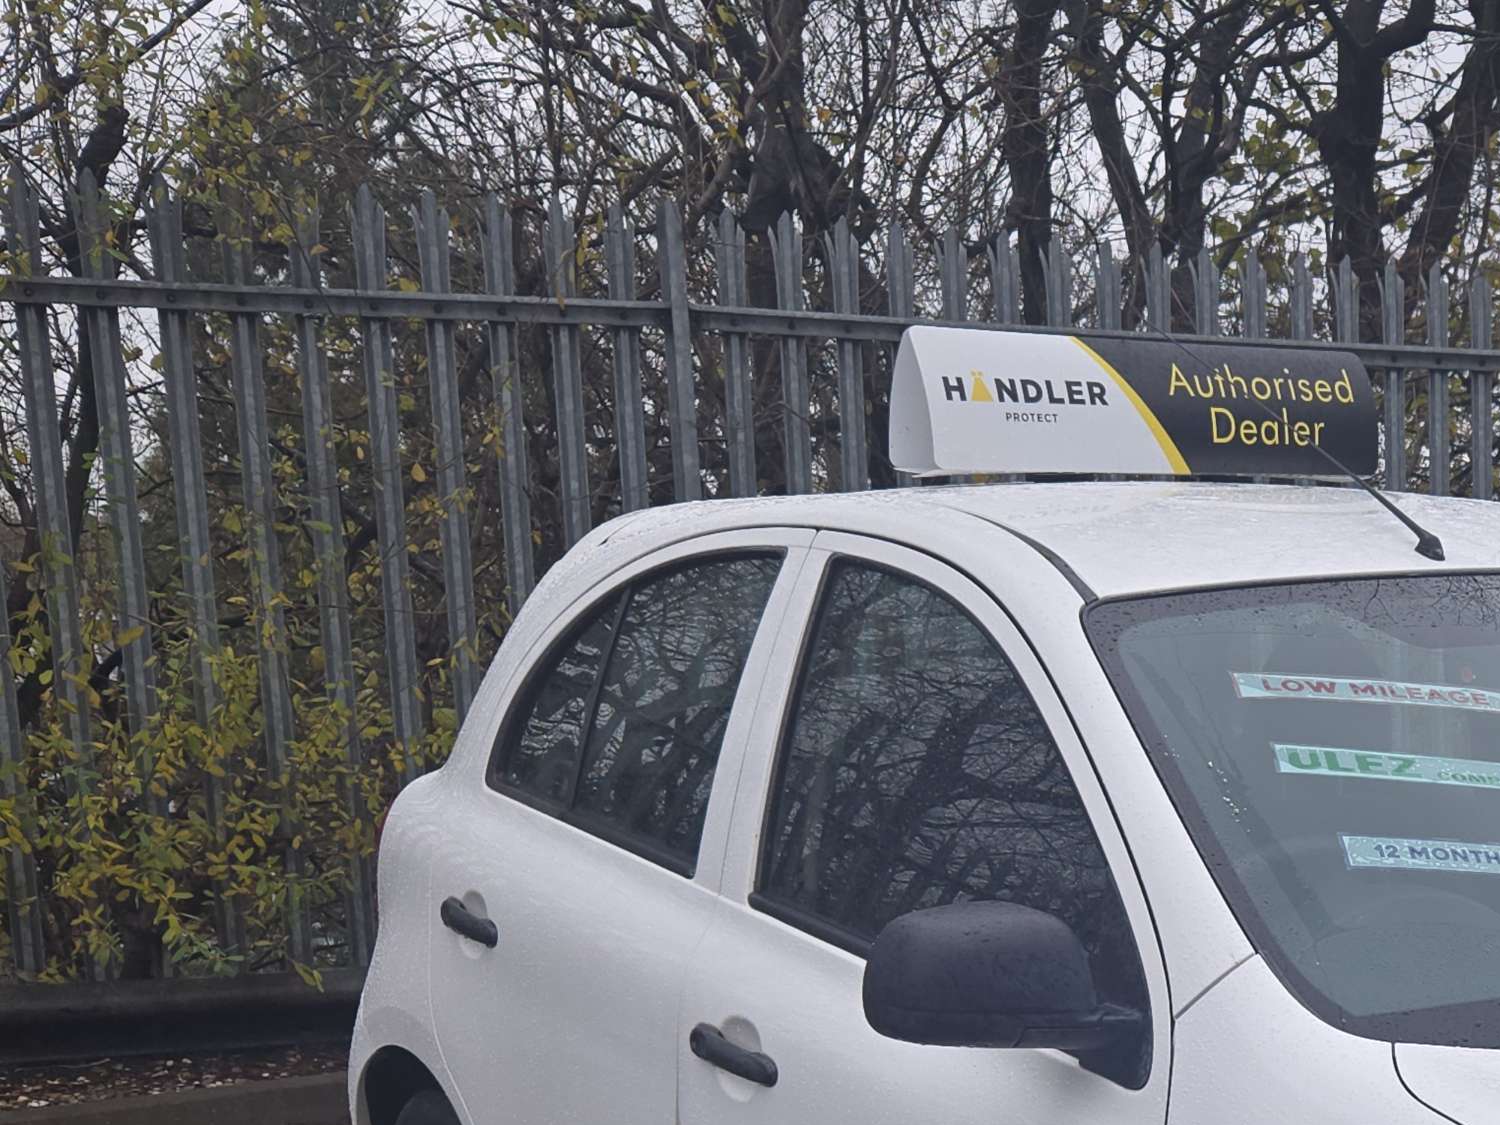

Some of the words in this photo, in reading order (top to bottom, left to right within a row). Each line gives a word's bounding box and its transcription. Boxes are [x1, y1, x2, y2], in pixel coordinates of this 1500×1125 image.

[1168, 362, 1355, 404] Authorised
[1005, 411, 1059, 424] PROTECT
[1211, 406, 1326, 447] Dealer
[1262, 678, 1337, 694] LOW
[1349, 682, 1490, 705] MILEAGE
[1287, 749, 1425, 778] ULEZ
[1373, 844, 1401, 859] 12
